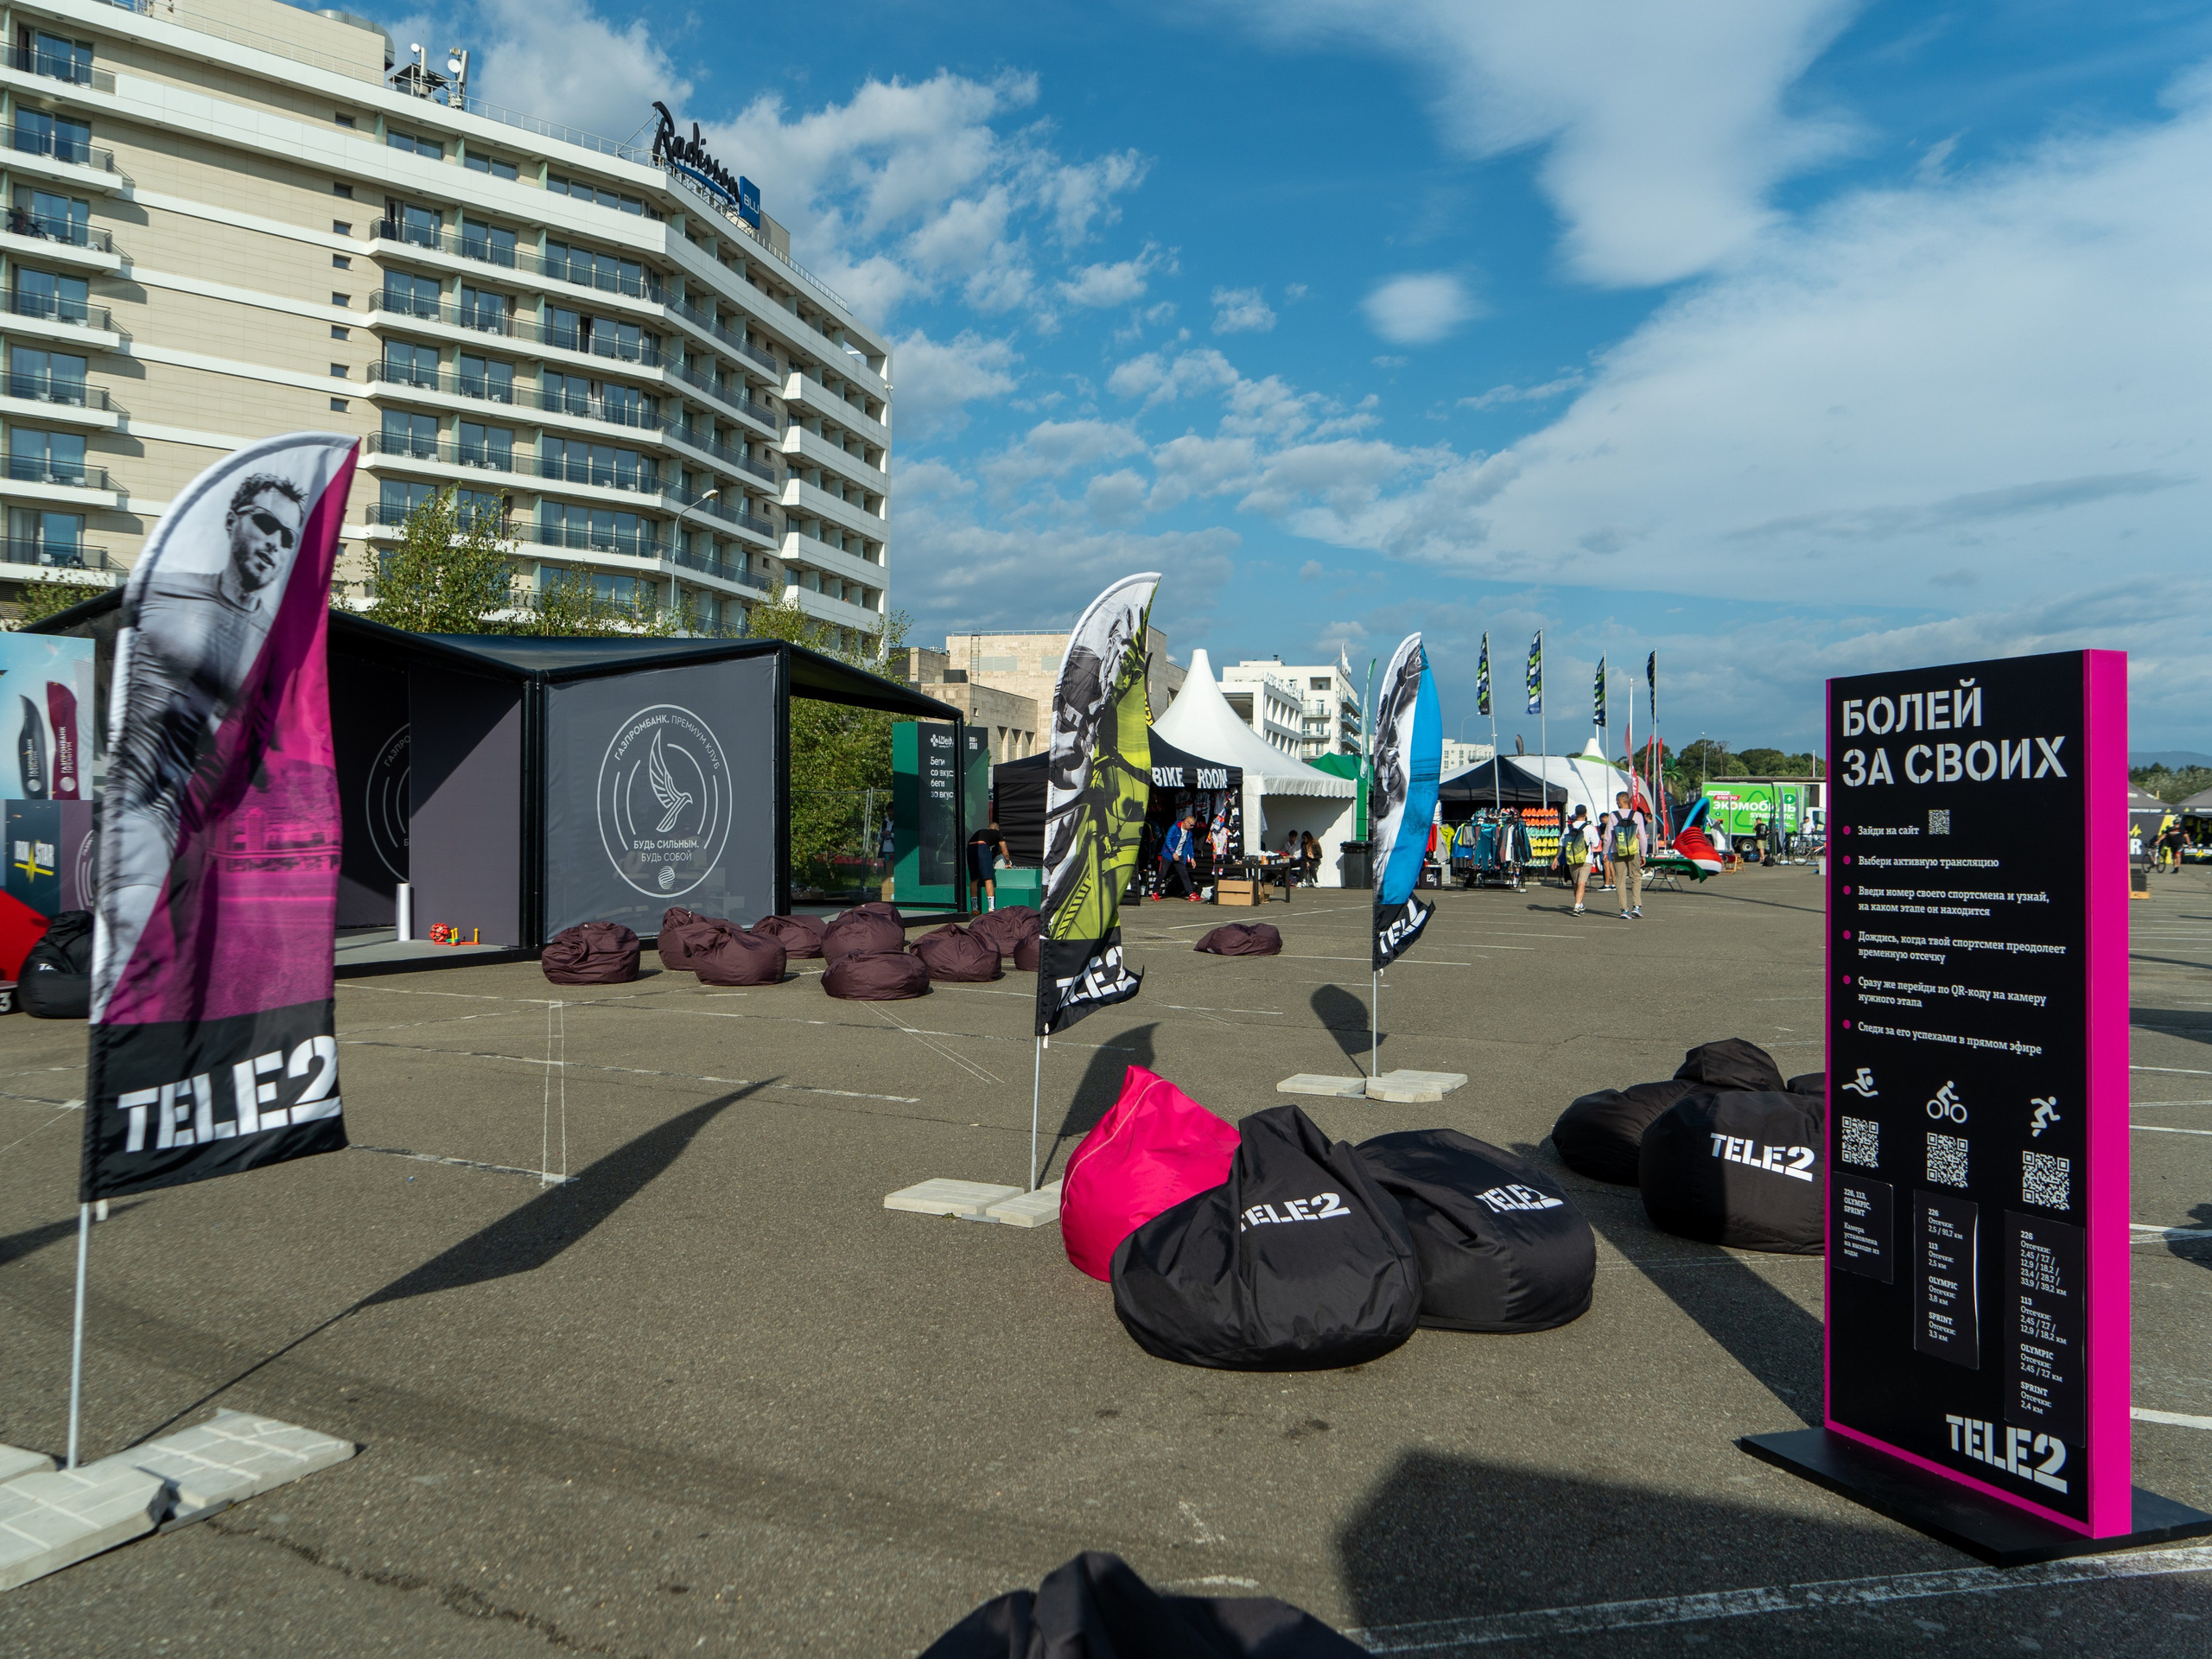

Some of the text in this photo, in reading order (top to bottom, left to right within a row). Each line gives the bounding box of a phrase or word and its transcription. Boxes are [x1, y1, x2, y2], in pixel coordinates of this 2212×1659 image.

[652, 101, 760, 214] Radisson BLU
[1843, 677, 1981, 736] БОЛЕЙ
[614, 715, 721, 769] ГАЗПРОМБАНК. ПРЕМИУМ КЛУБ
[1842, 736, 2068, 786] ЗА СВОИХ
[1151, 766, 1228, 789] BIKE ROOM
[1858, 825, 1885, 836] Зайди
[1898, 825, 1919, 835] сайт
[633, 840, 699, 850] БУДЬ СИЛЬНЫМ.
[641, 849, 691, 862] БУДЬ СОБОЙ
[1859, 855, 1999, 869] Выбери активную трансляцию
[1859, 886, 1885, 898] Введи
[1886, 888, 1915, 899] номер
[1948, 891, 2005, 901] спортсмена
[2017, 892, 2050, 904] узнай,
[1900, 905, 1925, 913] этапе
[1940, 906, 1990, 916] находится
[1859, 931, 2066, 954] Дождись, когда твой спортсмен преодолеет
[1859, 949, 1946, 964] временную отсечку
[1858, 976, 1882, 990] Сразу
[1897, 982, 1936, 994] перейди
[1951, 985, 1991, 1001] QR-коду
[1993, 991, 2005, 1000] на
[2007, 992, 2047, 1007] камеру
[1859, 994, 1923, 1007] нужного этапа
[1858, 1021, 1884, 1035] Следи
[1885, 1027, 1895, 1035] за
[1896, 1028, 1911, 1037] его
[1912, 1030, 1957, 1044] успехами
[1967, 1037, 2008, 1050] прямом
[2010, 1040, 2043, 1056] эфире
[118, 1035, 342, 1153] TELE2
[1710, 1132, 1815, 1182] TELE2
[1843, 1205, 1866, 1217] SPRINT
[1928, 1208, 1939, 1217] 226
[2020, 1230, 2033, 1240] 226
[1928, 1242, 1938, 1250] 113
[2020, 1240, 2051, 1254] Отсечки:
[2020, 1249, 2035, 1259] 2,45
[1928, 1258, 1937, 1267] 2,5
[2020, 1259, 2034, 1268] 12,9
[2040, 1263, 2054, 1274] 18,2
[1929, 1275, 1958, 1290] OLYMPIC
[2020, 1268, 2034, 1278] 23,4
[2040, 1273, 2055, 1283] 28,7
[2020, 1277, 2035, 1287] 33,9
[2040, 1282, 2055, 1293] 39,2
[2056, 1287, 2067, 1296] км
[2020, 1296, 2032, 1306] 113
[1929, 1312, 1953, 1325] SPRINT
[2020, 1306, 2051, 1320] Отсечки:
[2020, 1314, 2035, 1325] 2,45
[2020, 1324, 2034, 1335] 12,9
[2040, 1330, 2055, 1341] 18,2
[2056, 1336, 2067, 1344] км
[2020, 1344, 2054, 1360] OLYMPIC
[2020, 1353, 2051, 1369] Отсечки:
[2020, 1362, 2035, 1373] 2,45
[2051, 1374, 2063, 1382] км
[2020, 1381, 2048, 1396] SPRINT
[2020, 1390, 2052, 1408] Отсечки:
[2020, 1400, 2044, 1414] 2,4 км
[1946, 1414, 2068, 1494] TELE2
